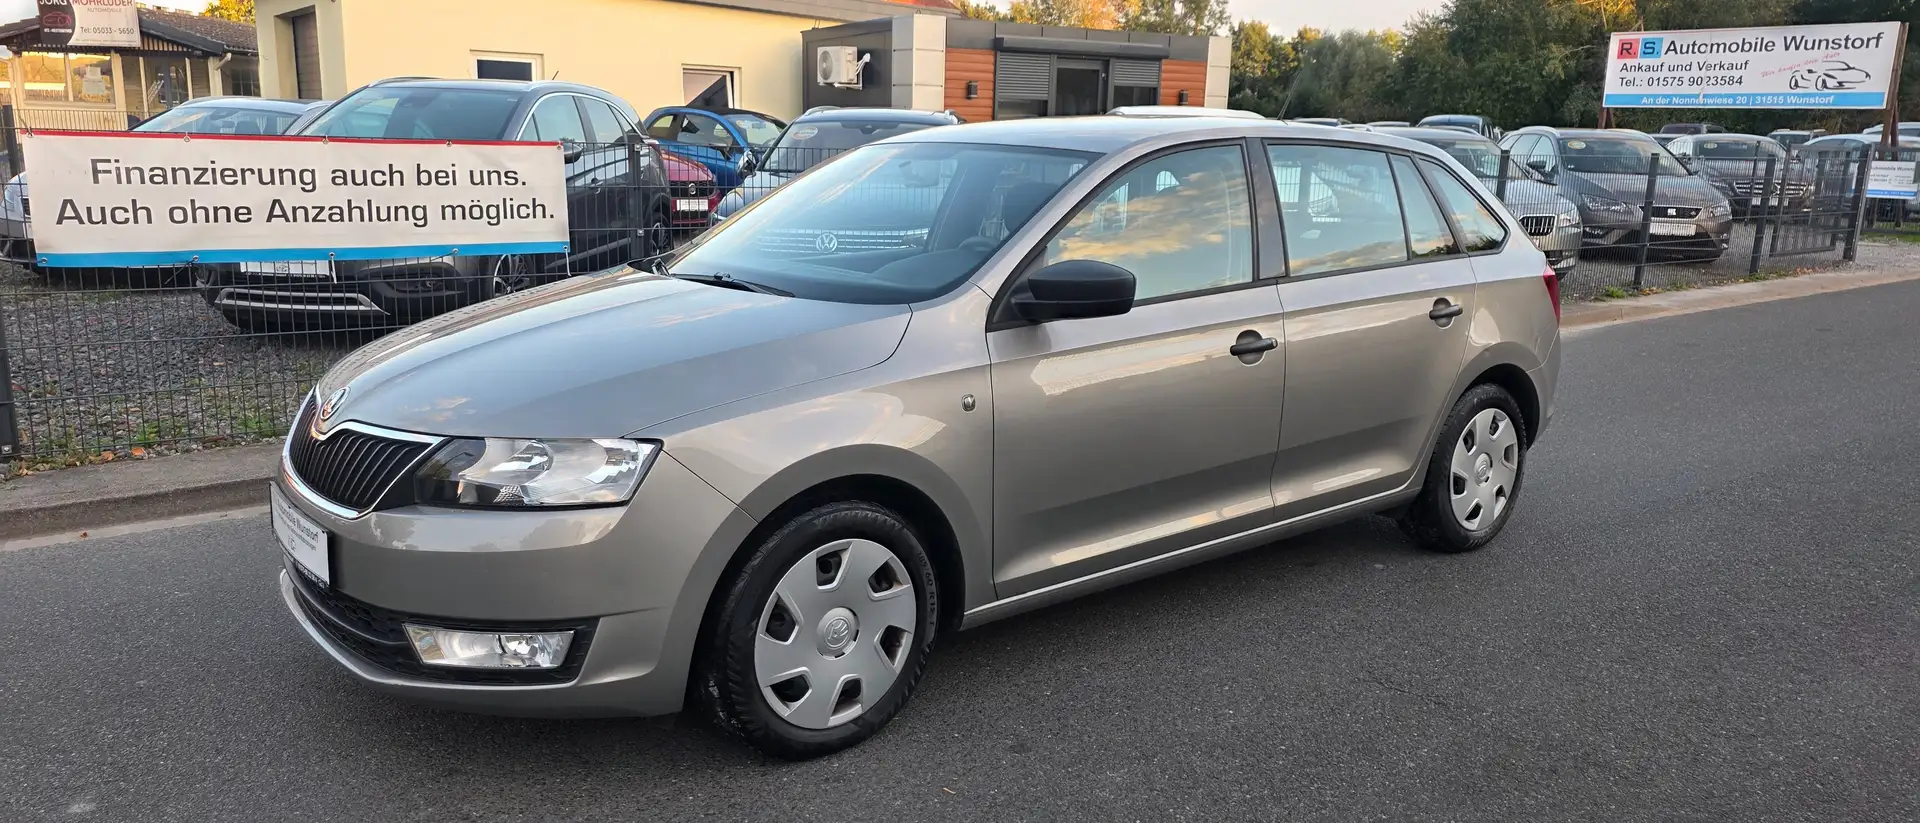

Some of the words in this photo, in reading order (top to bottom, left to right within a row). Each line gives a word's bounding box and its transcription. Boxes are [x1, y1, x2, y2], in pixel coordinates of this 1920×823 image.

[93, 26, 113, 34] 05033
[118, 27, 135, 35] 5650
[1664, 37, 1776, 55] Automobile
[1783, 32, 1884, 51] Wunstorf
[1620, 62, 1665, 73] Ankauf
[1668, 61, 1692, 72] und
[1697, 60, 1750, 71] Verkauf
[1619, 77, 1643, 87] Tel.:
[1647, 76, 1684, 87] 01575
[1641, 96, 1653, 104] An
[1655, 96, 1669, 104] der
[1736, 95, 1746, 104] 20
[1755, 96, 1784, 104] 31515
[1786, 95, 1834, 104] Wunstorf
[91, 158, 317, 193] Finanzierung
[330, 163, 405, 187] auch
[416, 163, 457, 186] bei
[469, 168, 527, 186] uns.
[56, 198, 153, 225] Auch
[168, 198, 252, 224] ohne
[265, 198, 428, 228] Anzahlung
[441, 198, 555, 227] möglich.
